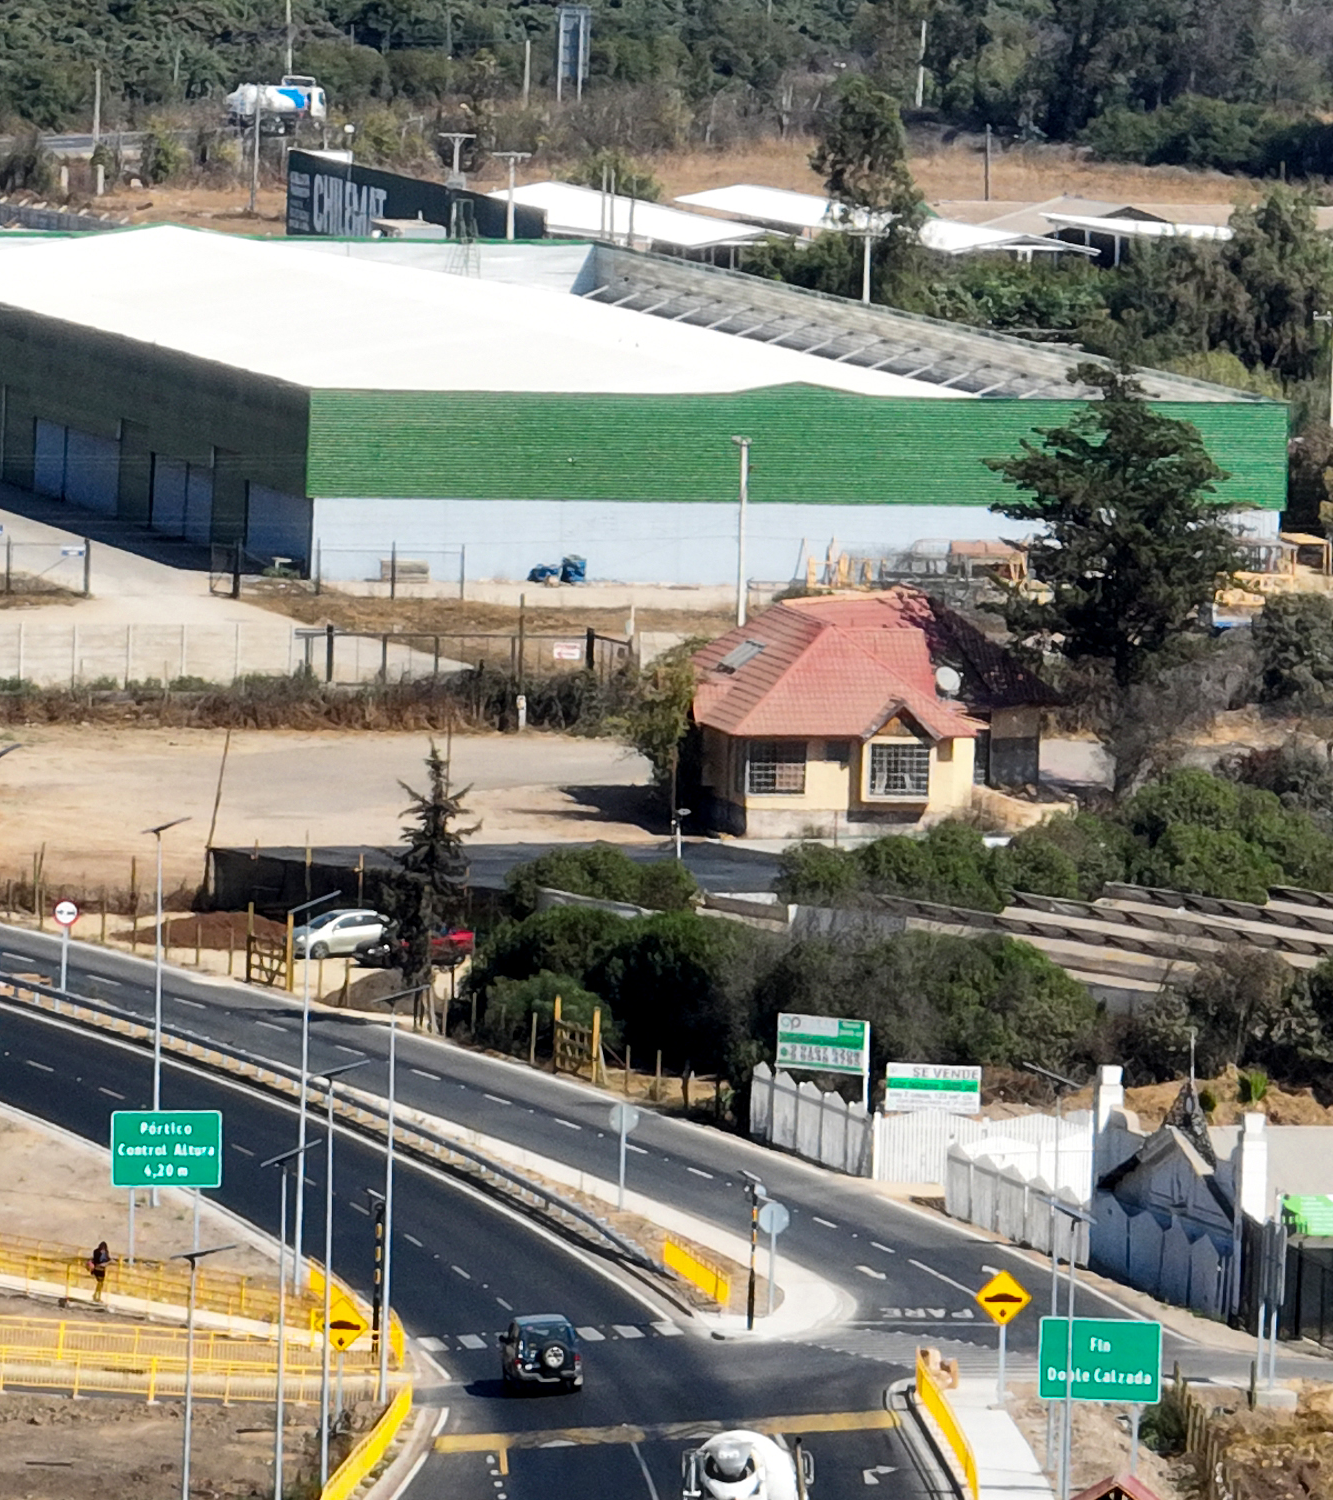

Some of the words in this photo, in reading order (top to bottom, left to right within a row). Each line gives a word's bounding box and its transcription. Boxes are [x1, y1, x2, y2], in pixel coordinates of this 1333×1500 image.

[913, 1067, 929, 1078] SE
[933, 1067, 979, 1079] VENDE
[140, 1121, 192, 1135] Pórtico
[118, 1143, 167, 1156] Control
[174, 1143, 215, 1156] Altura
[177, 1167, 188, 1177] m
[1090, 1337, 1112, 1352] Fin
[1047, 1367, 1090, 1383] Doble
[1094, 1368, 1152, 1385] Calzada
